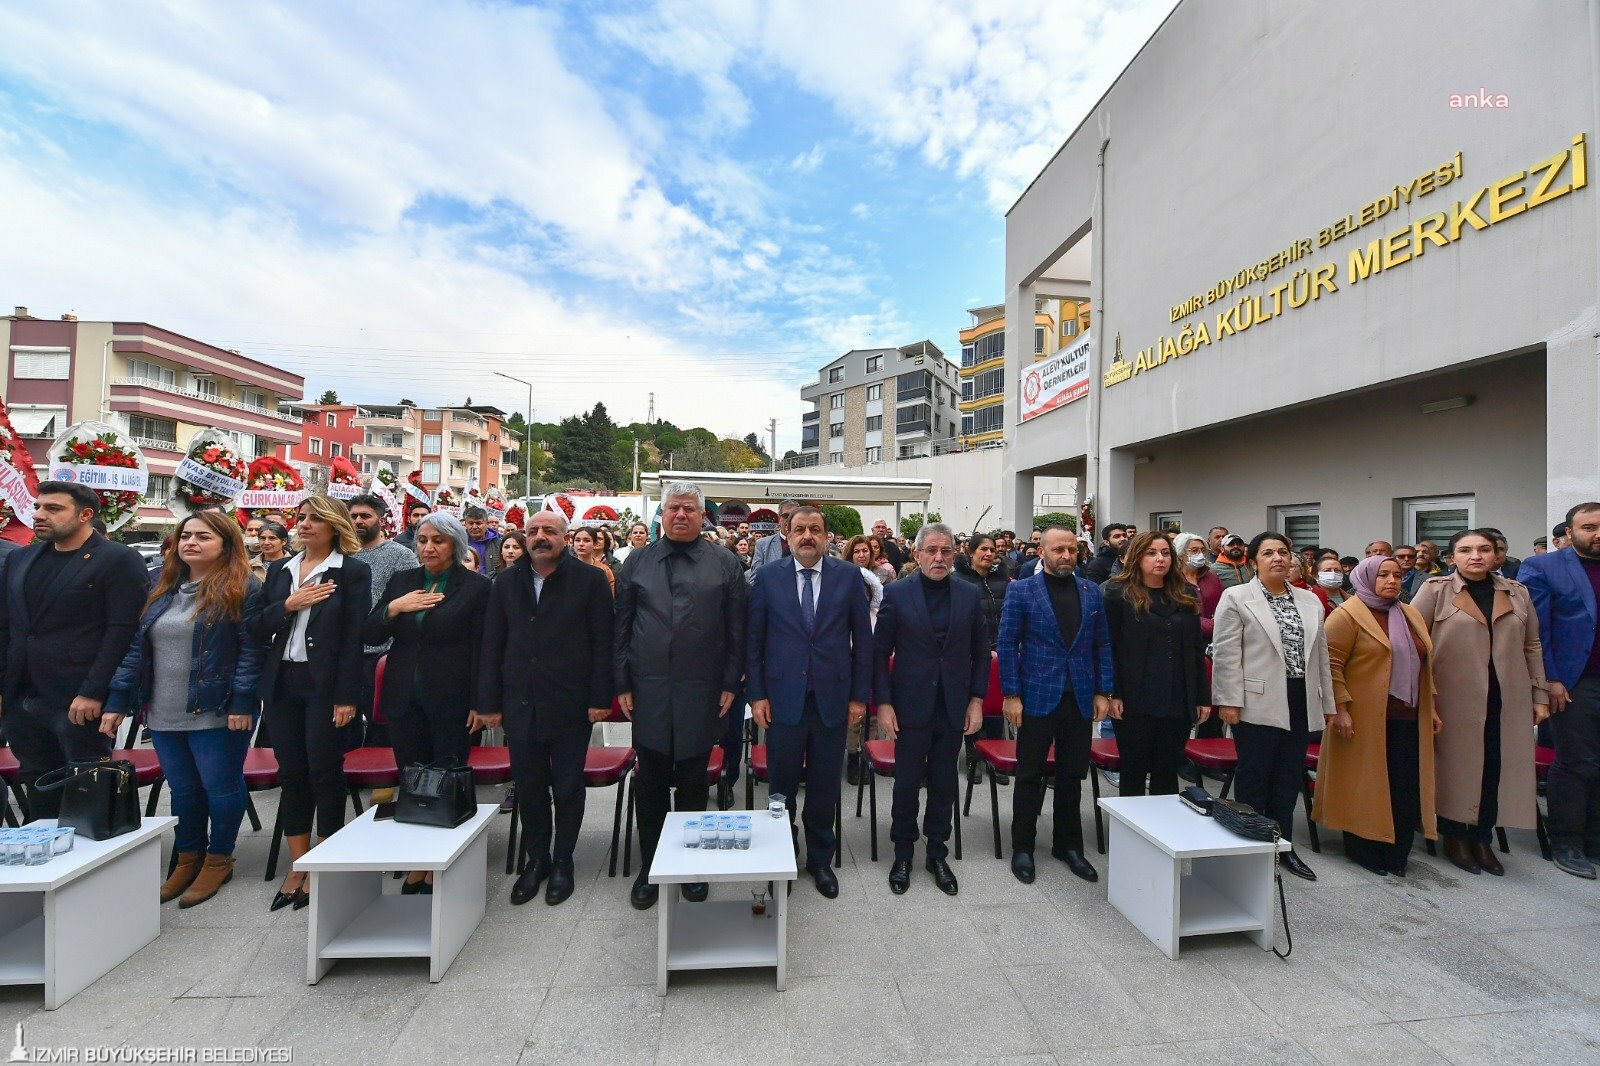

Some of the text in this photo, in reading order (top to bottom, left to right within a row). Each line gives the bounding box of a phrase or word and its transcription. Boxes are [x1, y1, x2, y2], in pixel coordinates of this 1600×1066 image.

[1134, 132, 1589, 377] ALİAĞA KÜLTÜR MERKEZİ
[1169, 151, 1464, 323] İZMİR BÜYÜKŞEHİR BELEDİYESİ
[1042, 342, 1090, 378] ALEVİ KÜLTÜR
[1044, 357, 1087, 391] DERNEKLERİ
[80, 469, 107, 484] EĞİTİM
